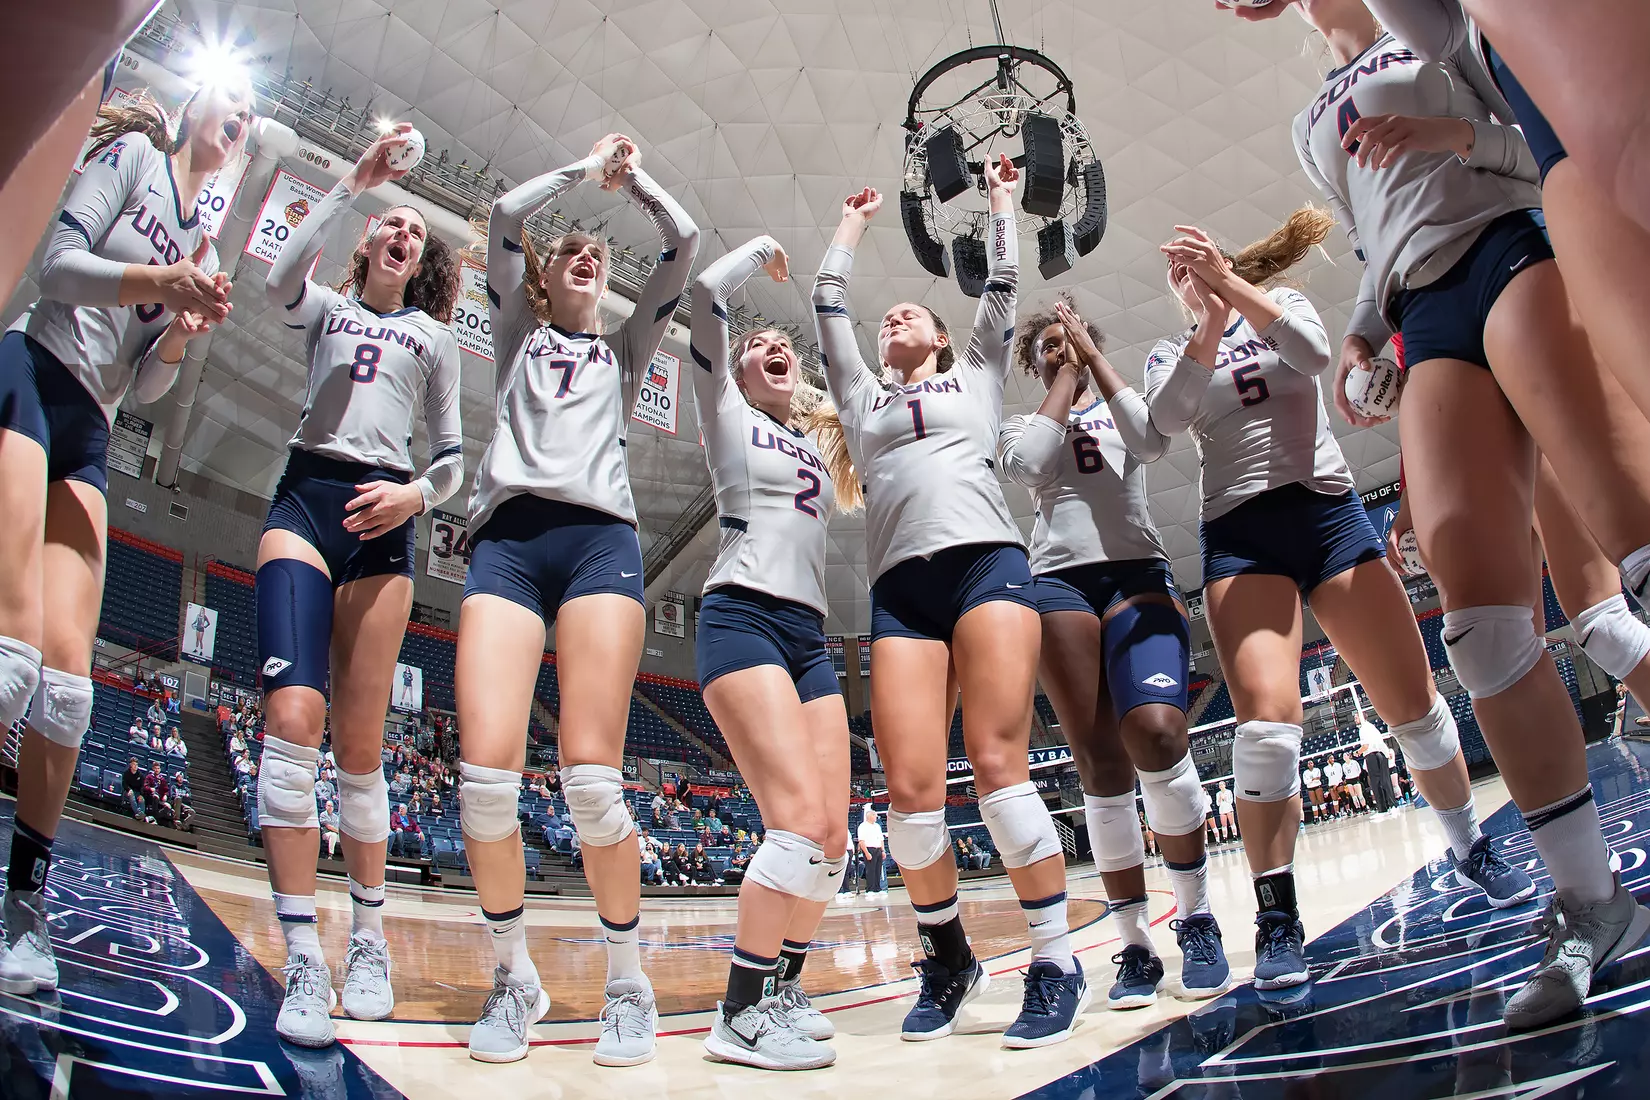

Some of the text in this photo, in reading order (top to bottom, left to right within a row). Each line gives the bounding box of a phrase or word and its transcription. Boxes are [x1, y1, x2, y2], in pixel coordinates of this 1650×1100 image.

[283, 174, 304, 188] UConn
[285, 206, 304, 221] Fina
[260, 218, 290, 242] 20
[995, 219, 1007, 262] HUSKIES
[454, 307, 492, 336] 200
[456, 326, 494, 348] NATIONA
[457, 337, 495, 358] HAMPION
[349, 343, 383, 384] 8
[549, 359, 578, 399] 7
[1230, 361, 1271, 407] 5
[1373, 368, 1394, 406] molten
[636, 402, 668, 420] ATIONAL
[640, 387, 671, 411] 010
[632, 410, 670, 430] HAMPIONS
[906, 398, 927, 441] 1
[1071, 435, 1105, 475] 6
[793, 467, 822, 520] 2
[1360, 490, 1378, 505] ITY
[1378, 485, 1392, 498] OF
[442, 513, 468, 526] RAY ALLE
[434, 522, 471, 566] 34
[162, 676, 180, 688] 107
[946, 760, 973, 772] CON
[1029, 749, 1069, 763] EYBA
